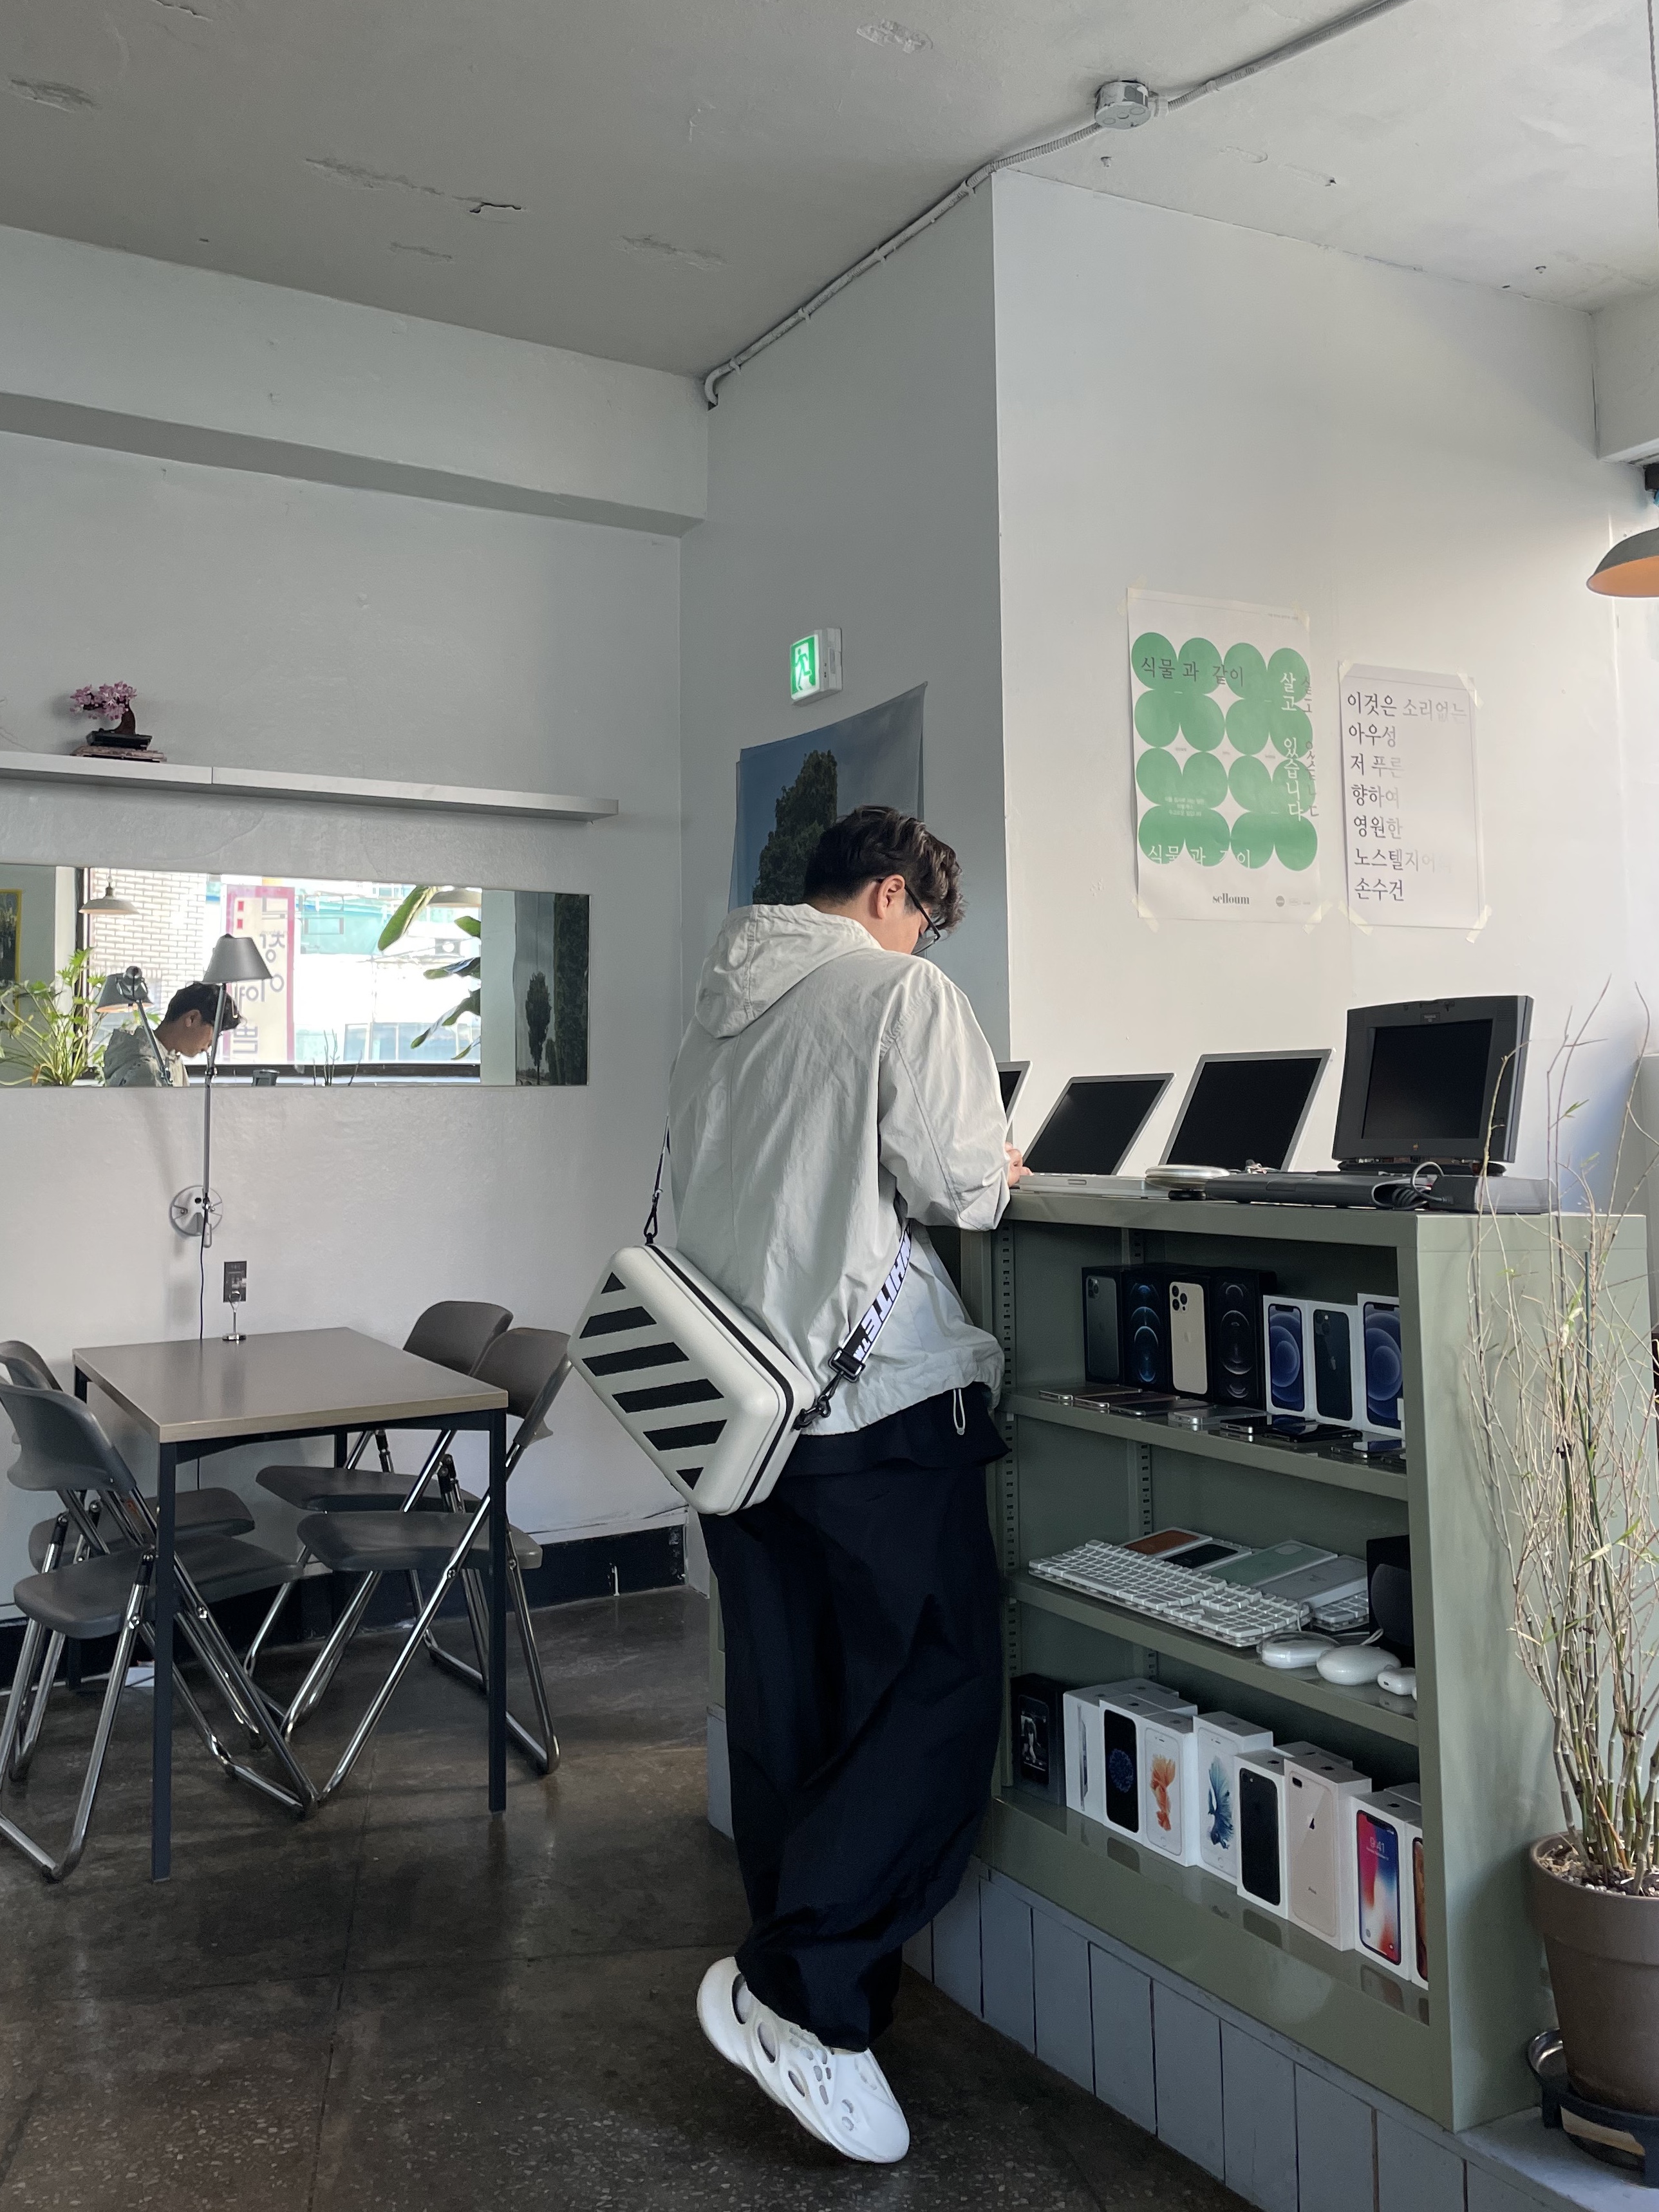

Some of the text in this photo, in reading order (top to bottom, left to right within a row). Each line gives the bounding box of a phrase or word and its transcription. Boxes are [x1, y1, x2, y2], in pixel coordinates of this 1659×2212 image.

[1213, 664, 1243, 687] 같이
[1347, 691, 1397, 717] 이것은
[1280, 671, 1304, 822] 살고 있습니다
[1349, 722, 1396, 747] 아우성
[1351, 753, 1364, 776] 저
[1354, 815, 1403, 839] 영원한
[1354, 848, 1451, 874] 노스텔지어
[1212, 892, 1250, 905] selloum
[1354, 877, 1404, 902] 손수건
